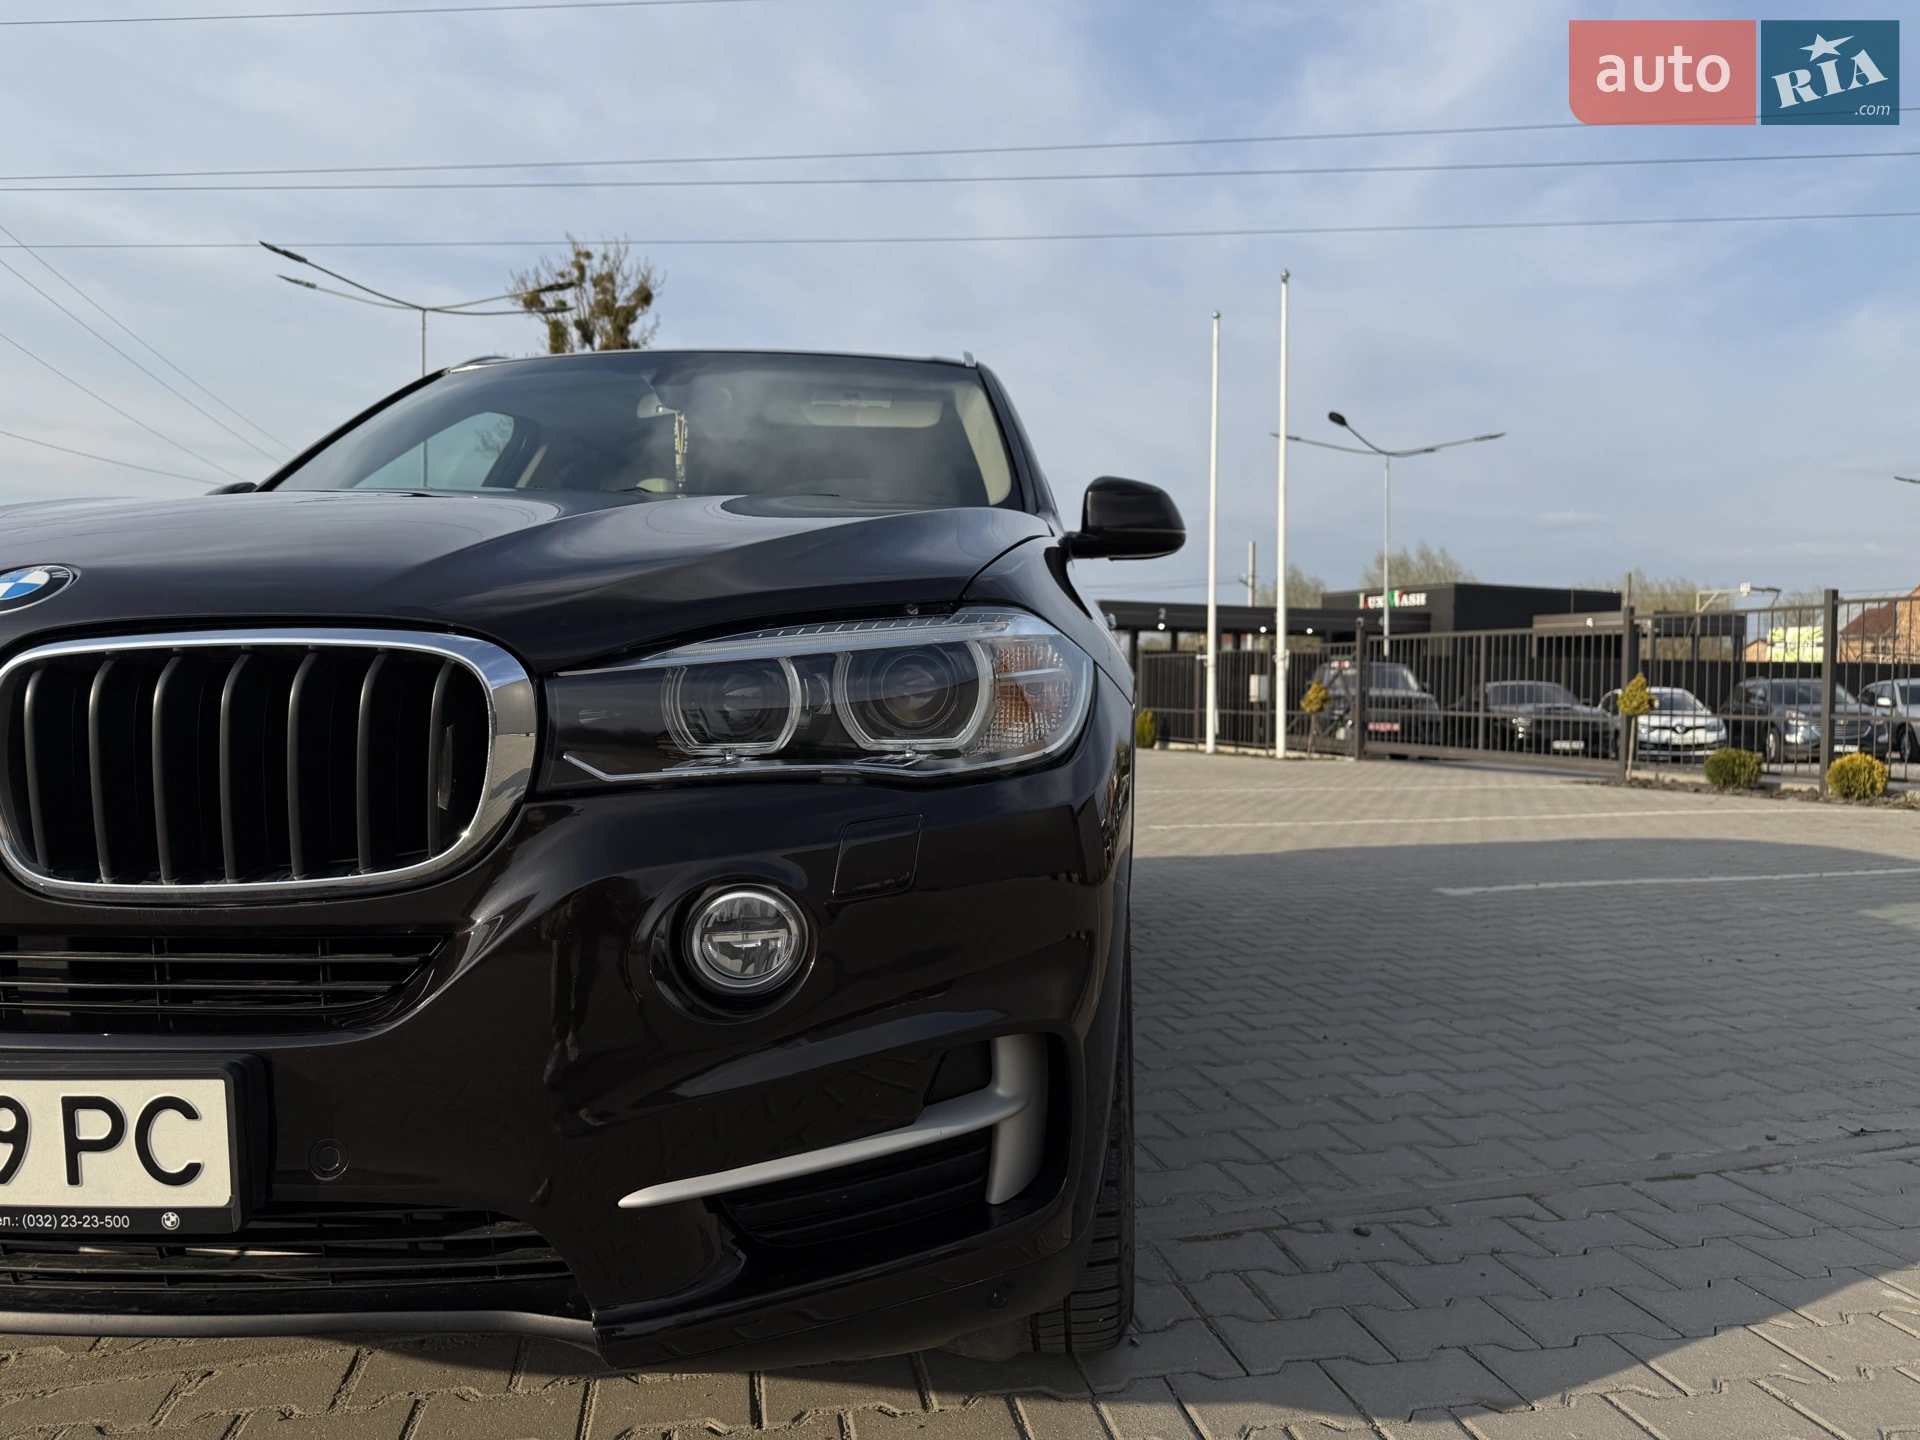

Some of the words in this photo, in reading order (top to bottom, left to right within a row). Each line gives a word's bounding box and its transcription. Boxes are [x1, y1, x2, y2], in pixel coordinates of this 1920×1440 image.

[61, 1095, 203, 1186] PC
[22, 1212, 57, 1230] (032)
[60, 1213, 130, 1228] 23-23-500
